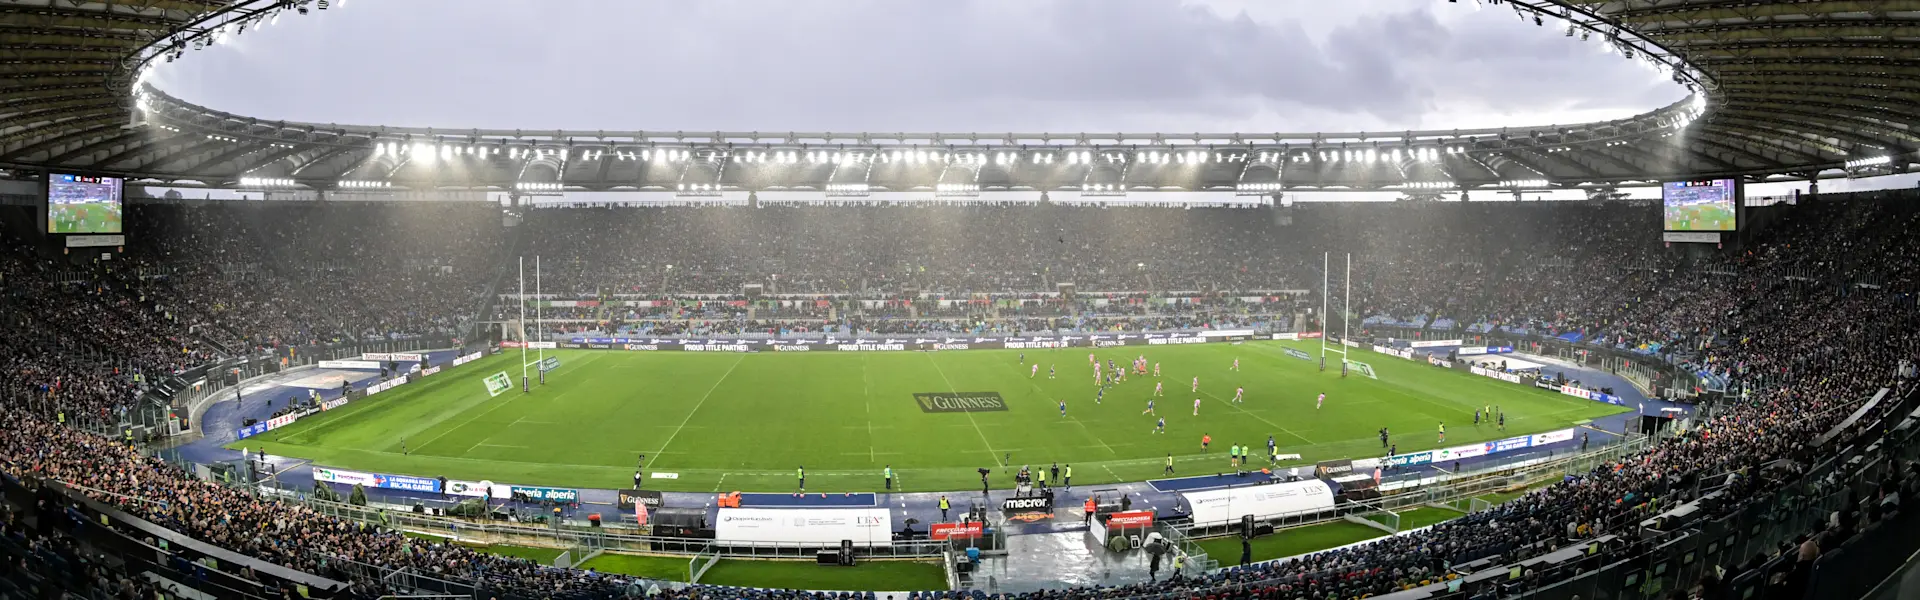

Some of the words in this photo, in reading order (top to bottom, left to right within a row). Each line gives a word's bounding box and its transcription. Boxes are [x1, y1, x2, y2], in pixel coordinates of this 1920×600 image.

[367, 384, 380, 396] PROUD
[380, 380, 390, 391] TITLE
[390, 375, 406, 388] PARTNER
[325, 396, 348, 410] GUINNESS
[933, 396, 1001, 409] GUINNESS
[1409, 453, 1431, 465] alperia
[1326, 464, 1351, 473] GUINNESS
[412, 483, 433, 492] CARNE
[545, 489, 575, 501] alperia
